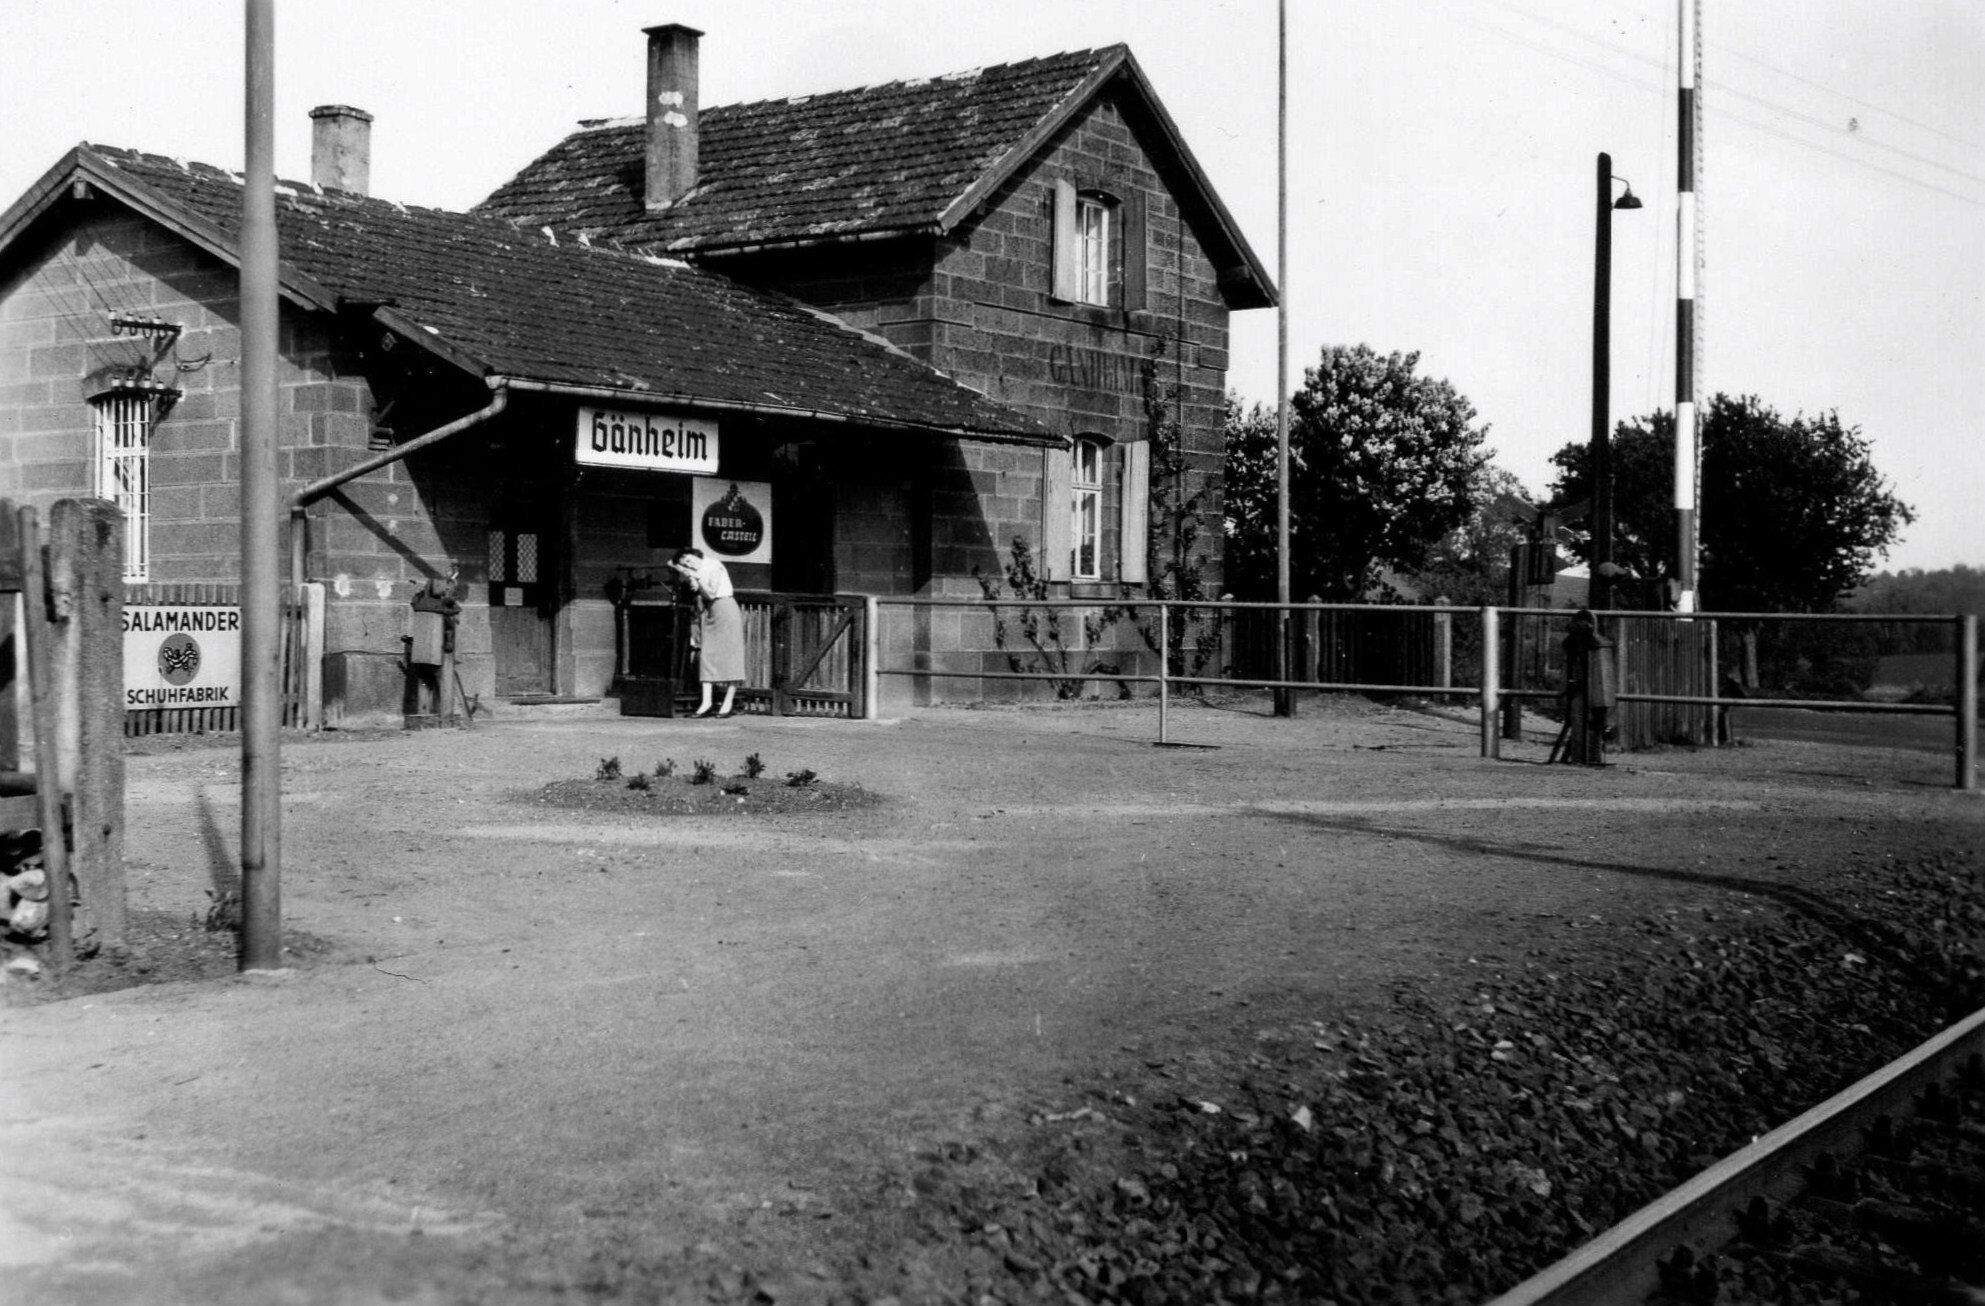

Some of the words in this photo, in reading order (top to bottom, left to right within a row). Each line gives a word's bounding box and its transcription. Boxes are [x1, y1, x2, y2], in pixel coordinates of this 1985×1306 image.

[591, 411, 708, 461] Gänheim
[720, 530, 758, 543] CASTELL
[121, 611, 239, 632] SALAMANDER
[127, 686, 229, 704] SCHUHFABRIK
